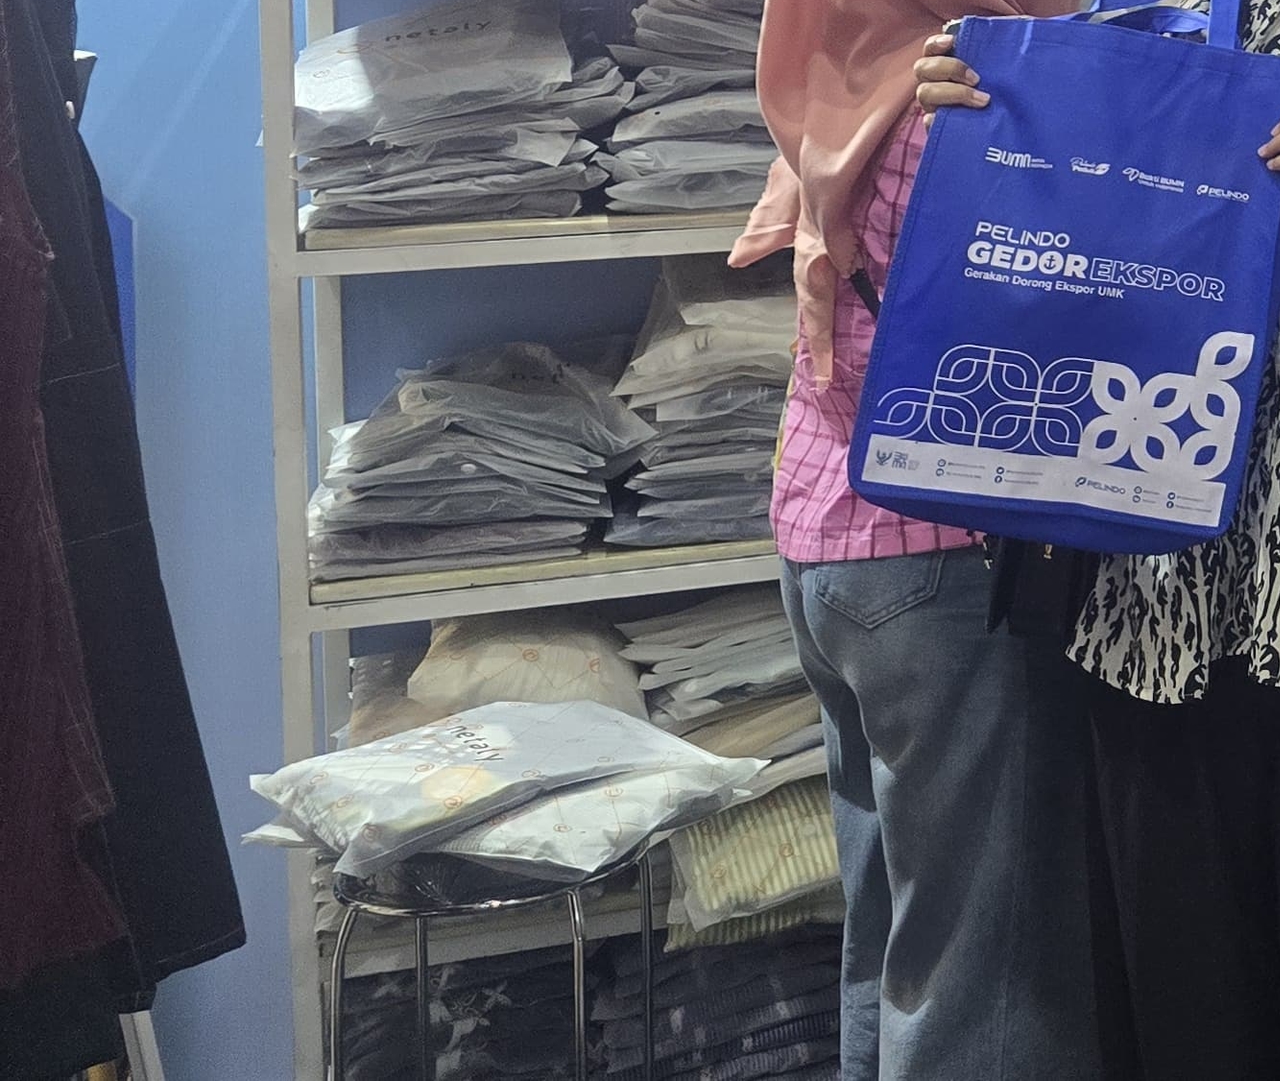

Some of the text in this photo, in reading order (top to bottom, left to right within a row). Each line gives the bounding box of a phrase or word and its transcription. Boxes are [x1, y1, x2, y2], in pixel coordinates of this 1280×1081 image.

[1208, 187, 1249, 201] PELINDO
[975, 221, 1070, 248] PELINDO
[964, 267, 1125, 299] Gerakan Dorong Ekspor UMK
[967, 240, 1225, 301] GEDOR EKSPOR
[446, 725, 504, 762] netaly
